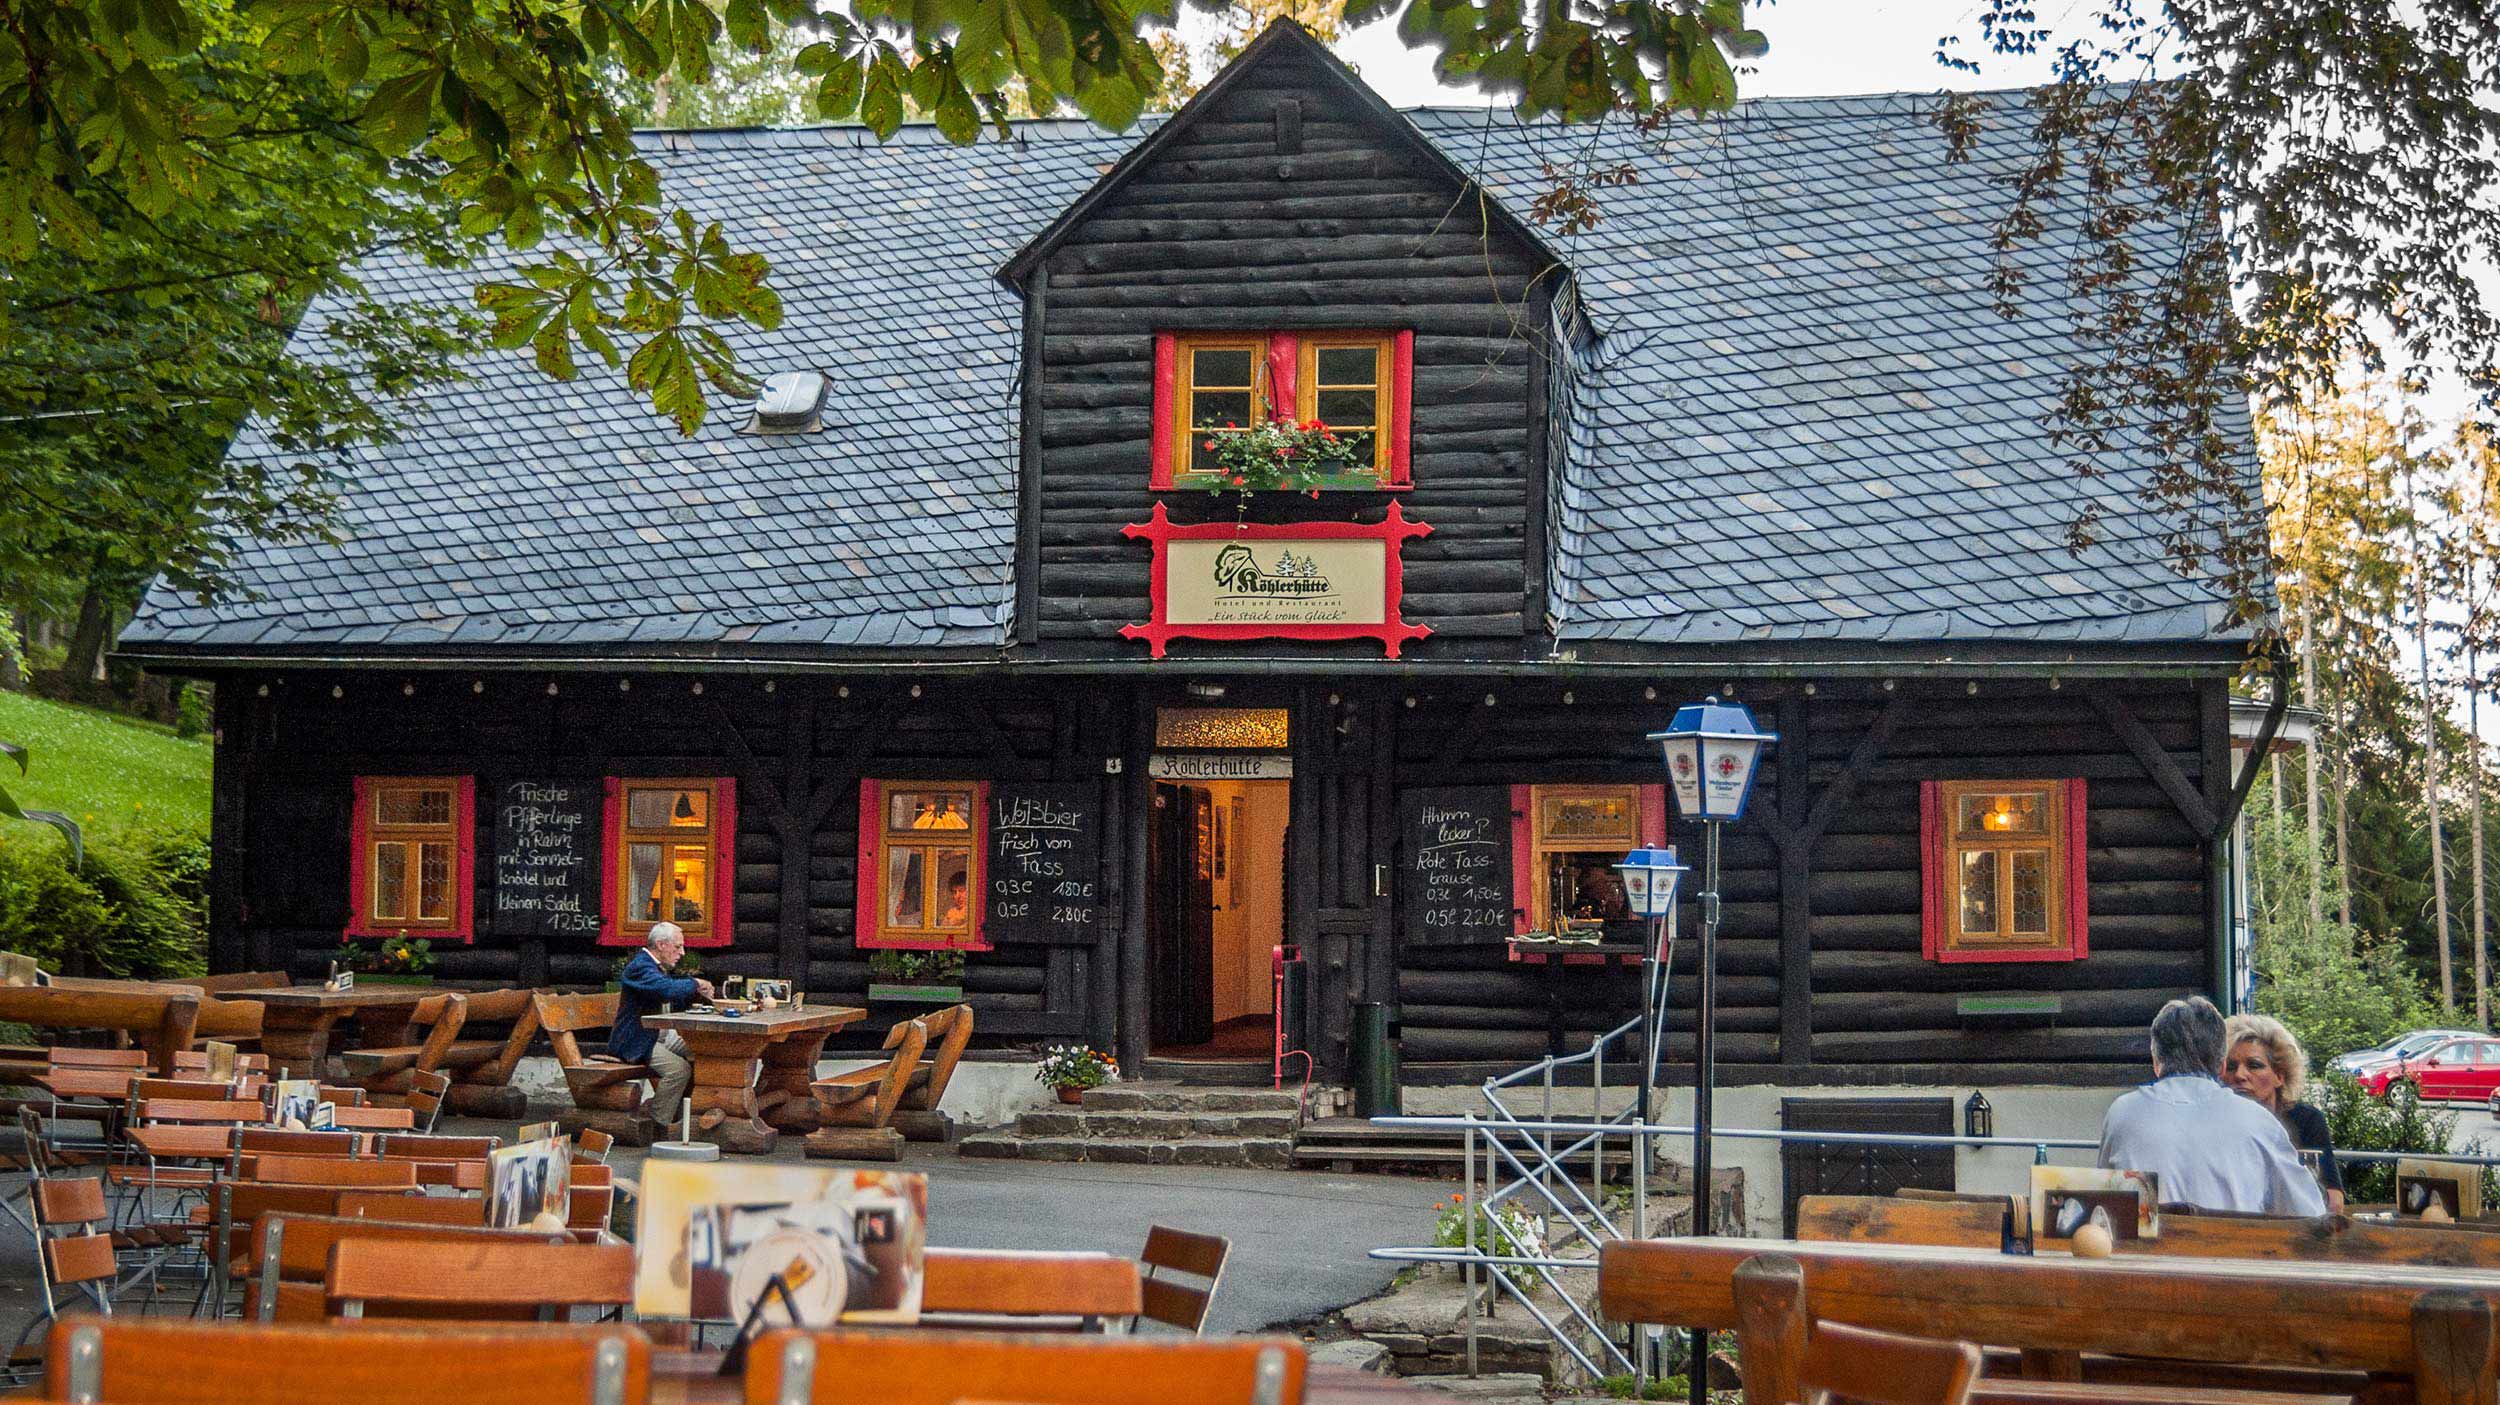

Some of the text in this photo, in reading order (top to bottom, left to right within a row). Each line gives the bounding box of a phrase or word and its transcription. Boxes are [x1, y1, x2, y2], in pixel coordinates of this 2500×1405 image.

[1237, 567, 1329, 596] Köhlerhütte
[1239, 610, 1270, 621] Stück
[1275, 613, 1300, 621] vom
[507, 782, 569, 802] Frische
[999, 797, 1082, 826] Weißbier
[518, 830, 573, 848] in Rahm
[999, 832, 1072, 856] frisch vom
[499, 849, 584, 867] mit Semmel-
[1016, 851, 1064, 876] Fass
[1416, 851, 1447, 871] Rote
[499, 869, 568, 886] knödel und
[1430, 873, 1474, 885] brause
[499, 891, 582, 912] kleinem Salat
